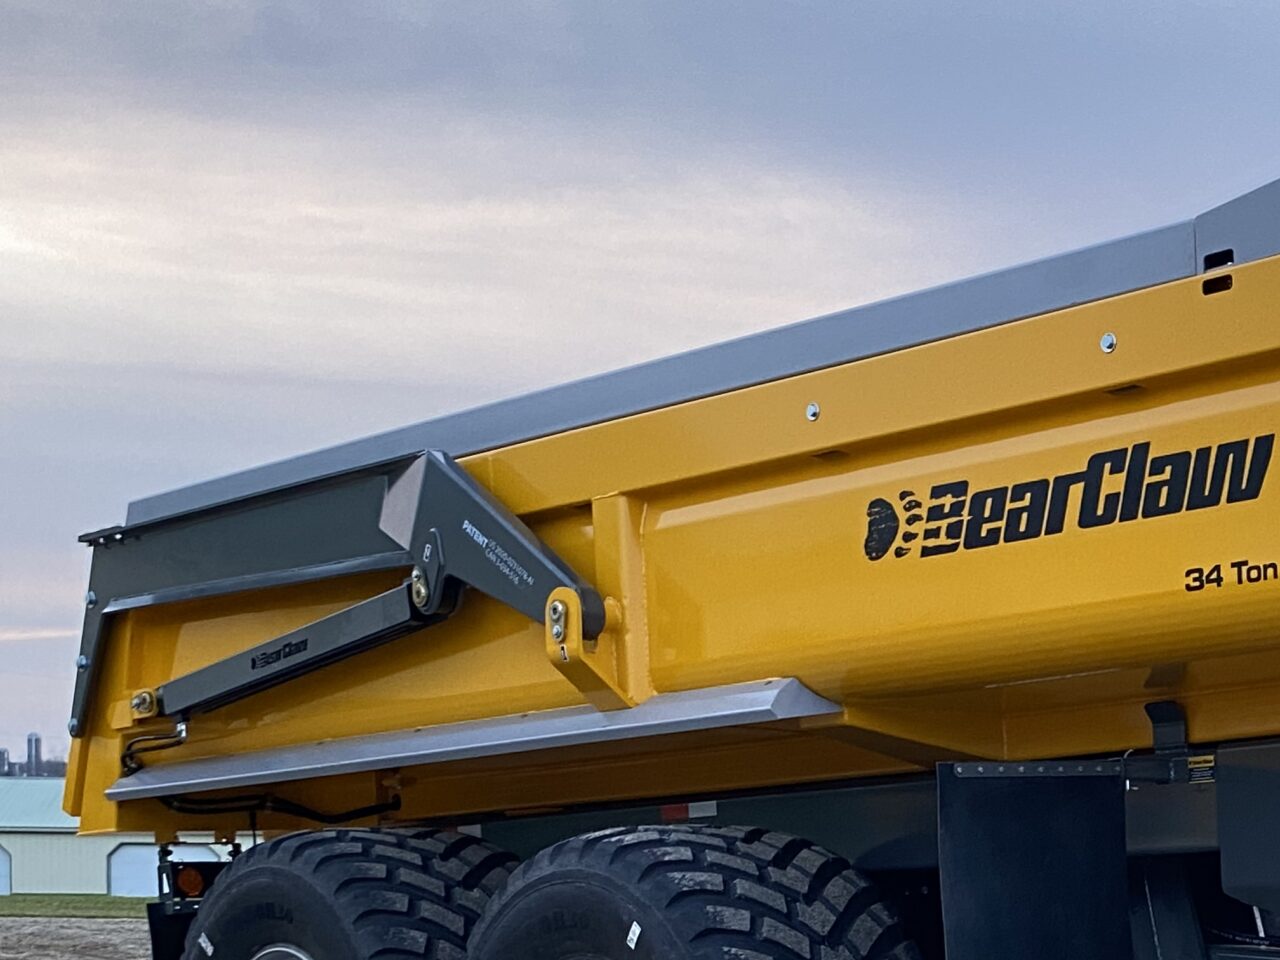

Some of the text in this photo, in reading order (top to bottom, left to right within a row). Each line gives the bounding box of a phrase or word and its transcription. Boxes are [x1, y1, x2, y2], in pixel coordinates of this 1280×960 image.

[920, 433, 1276, 559] BearClaw
[462, 519, 489, 549] PATENT
[1184, 559, 1279, 592] 34 Ton
